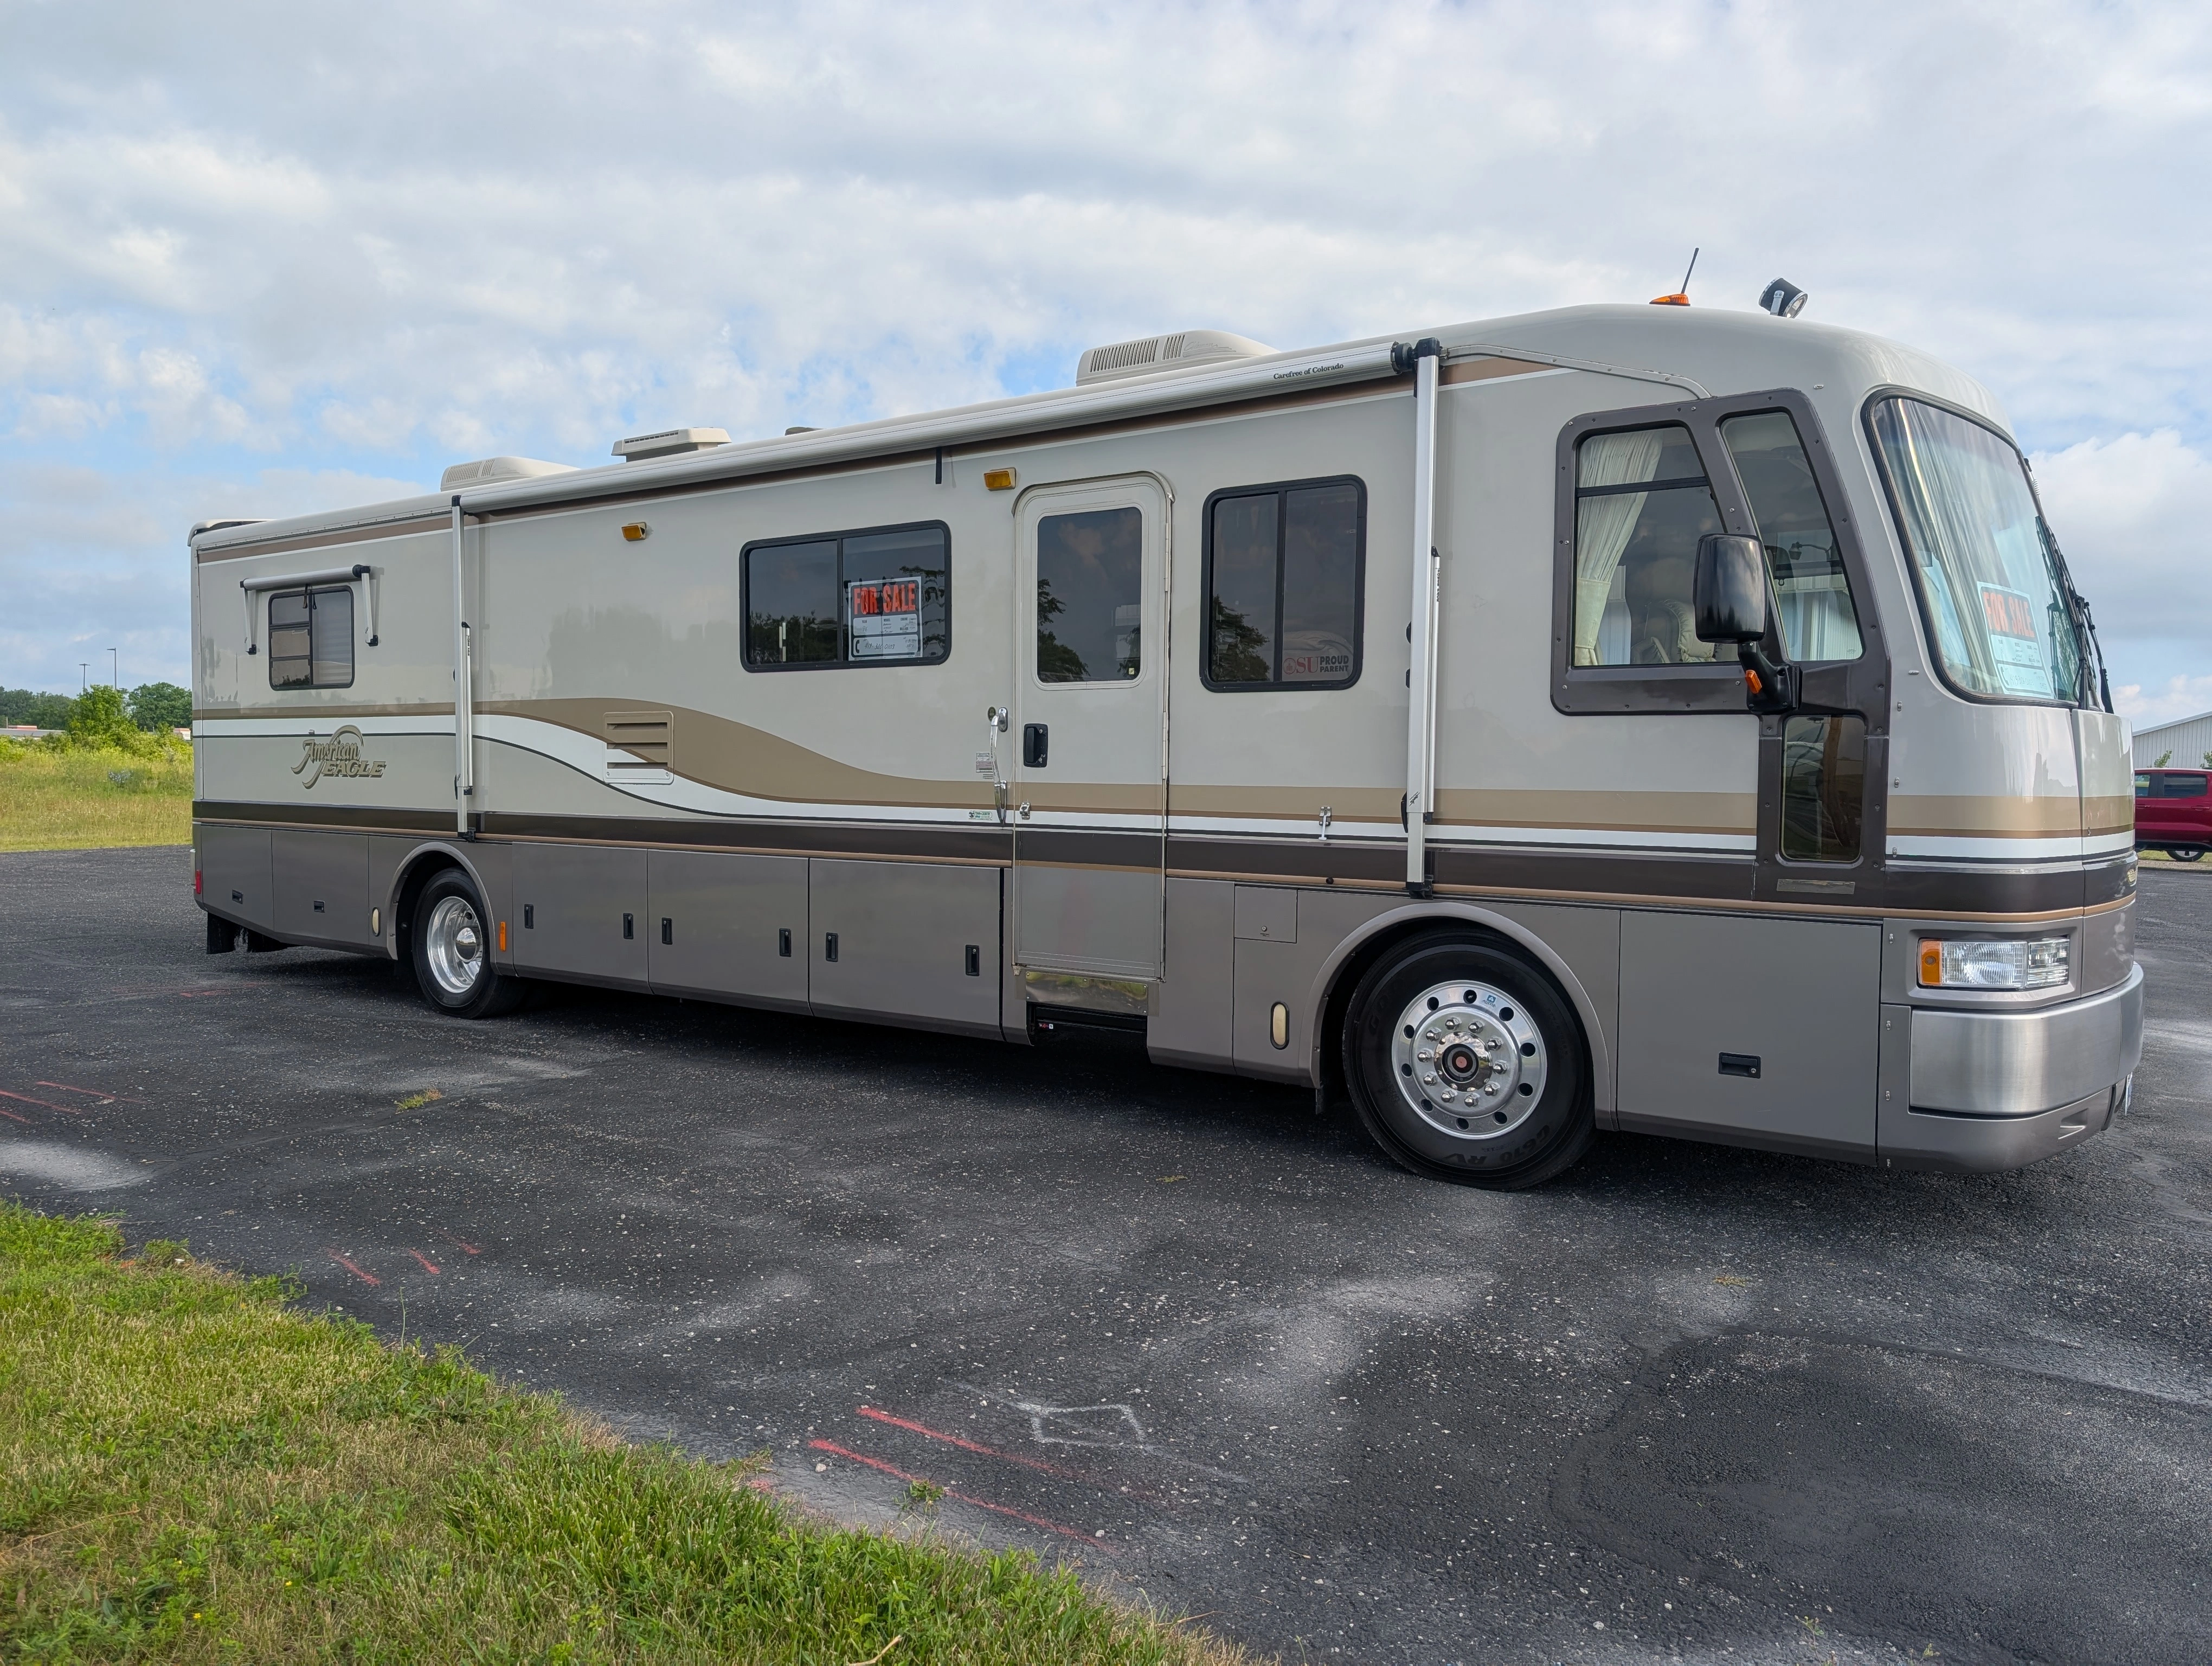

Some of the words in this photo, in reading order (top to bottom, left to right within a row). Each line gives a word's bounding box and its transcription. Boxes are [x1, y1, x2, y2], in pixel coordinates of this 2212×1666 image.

[1274, 371, 1303, 380] Carefree
[1312, 363, 1344, 373] Colorado
[854, 587, 877, 615] FOR
[883, 582, 916, 613] SALE
[1983, 592, 2009, 632] FOR
[2008, 596, 2035, 638] SALE
[1320, 655, 1349, 665] PROUD
[1320, 665, 1349, 673] PARENT
[291, 736, 362, 775] American
[321, 759, 387, 778] EAGLE
